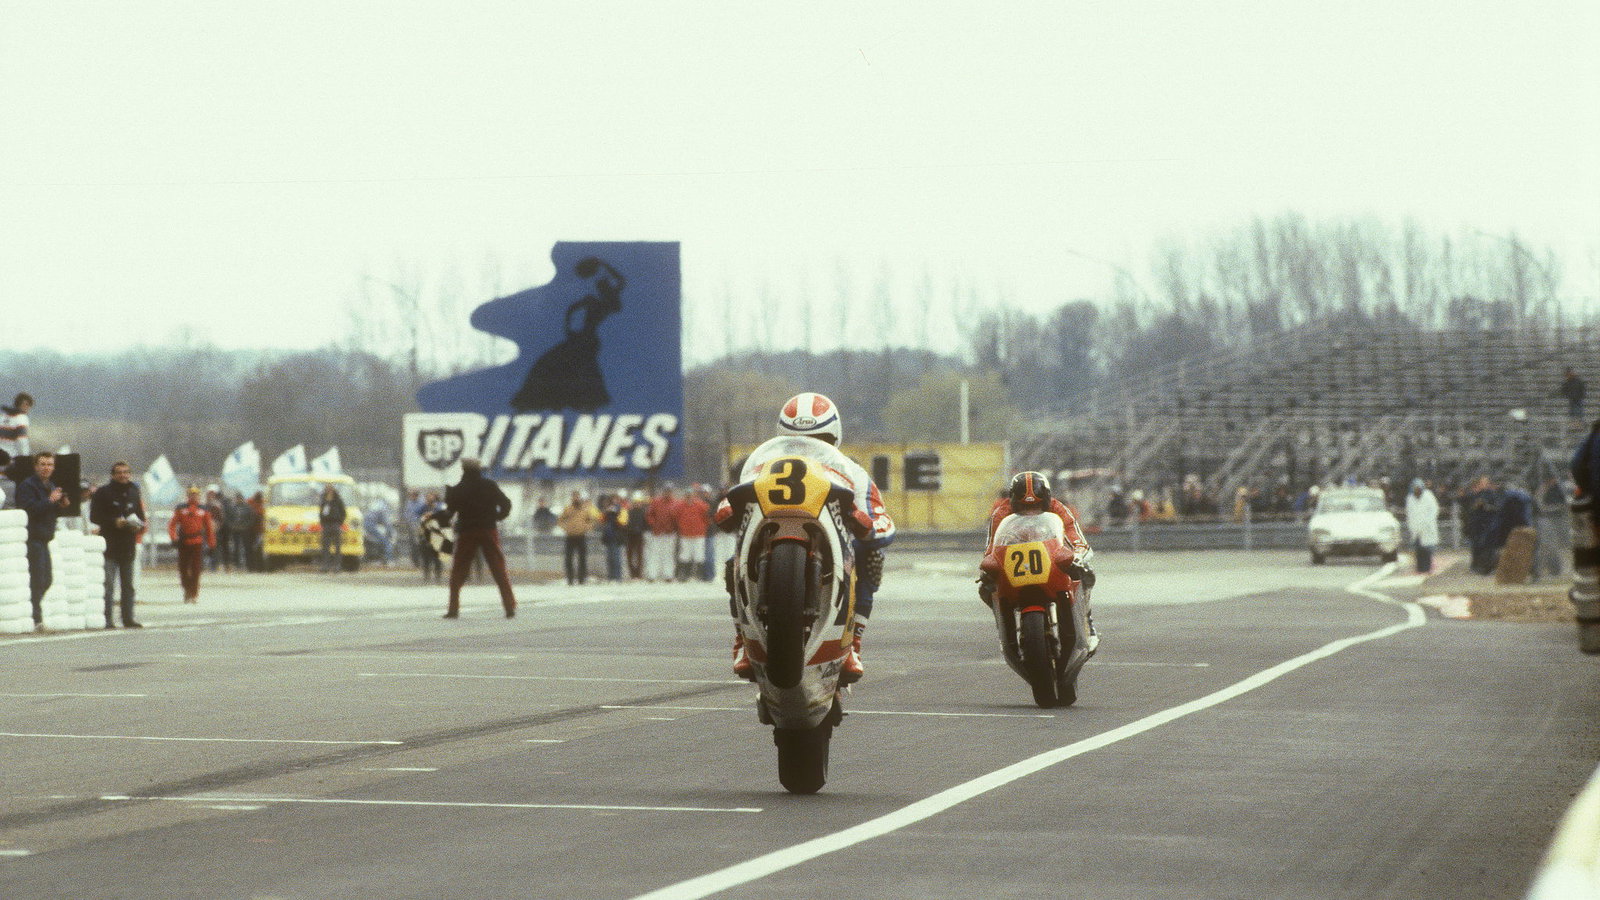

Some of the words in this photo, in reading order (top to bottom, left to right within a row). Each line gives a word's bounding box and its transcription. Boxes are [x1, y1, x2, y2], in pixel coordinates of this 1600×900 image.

[424, 435, 462, 461] BP
[768, 458, 808, 505] 3
[1010, 549, 1043, 577] 20
